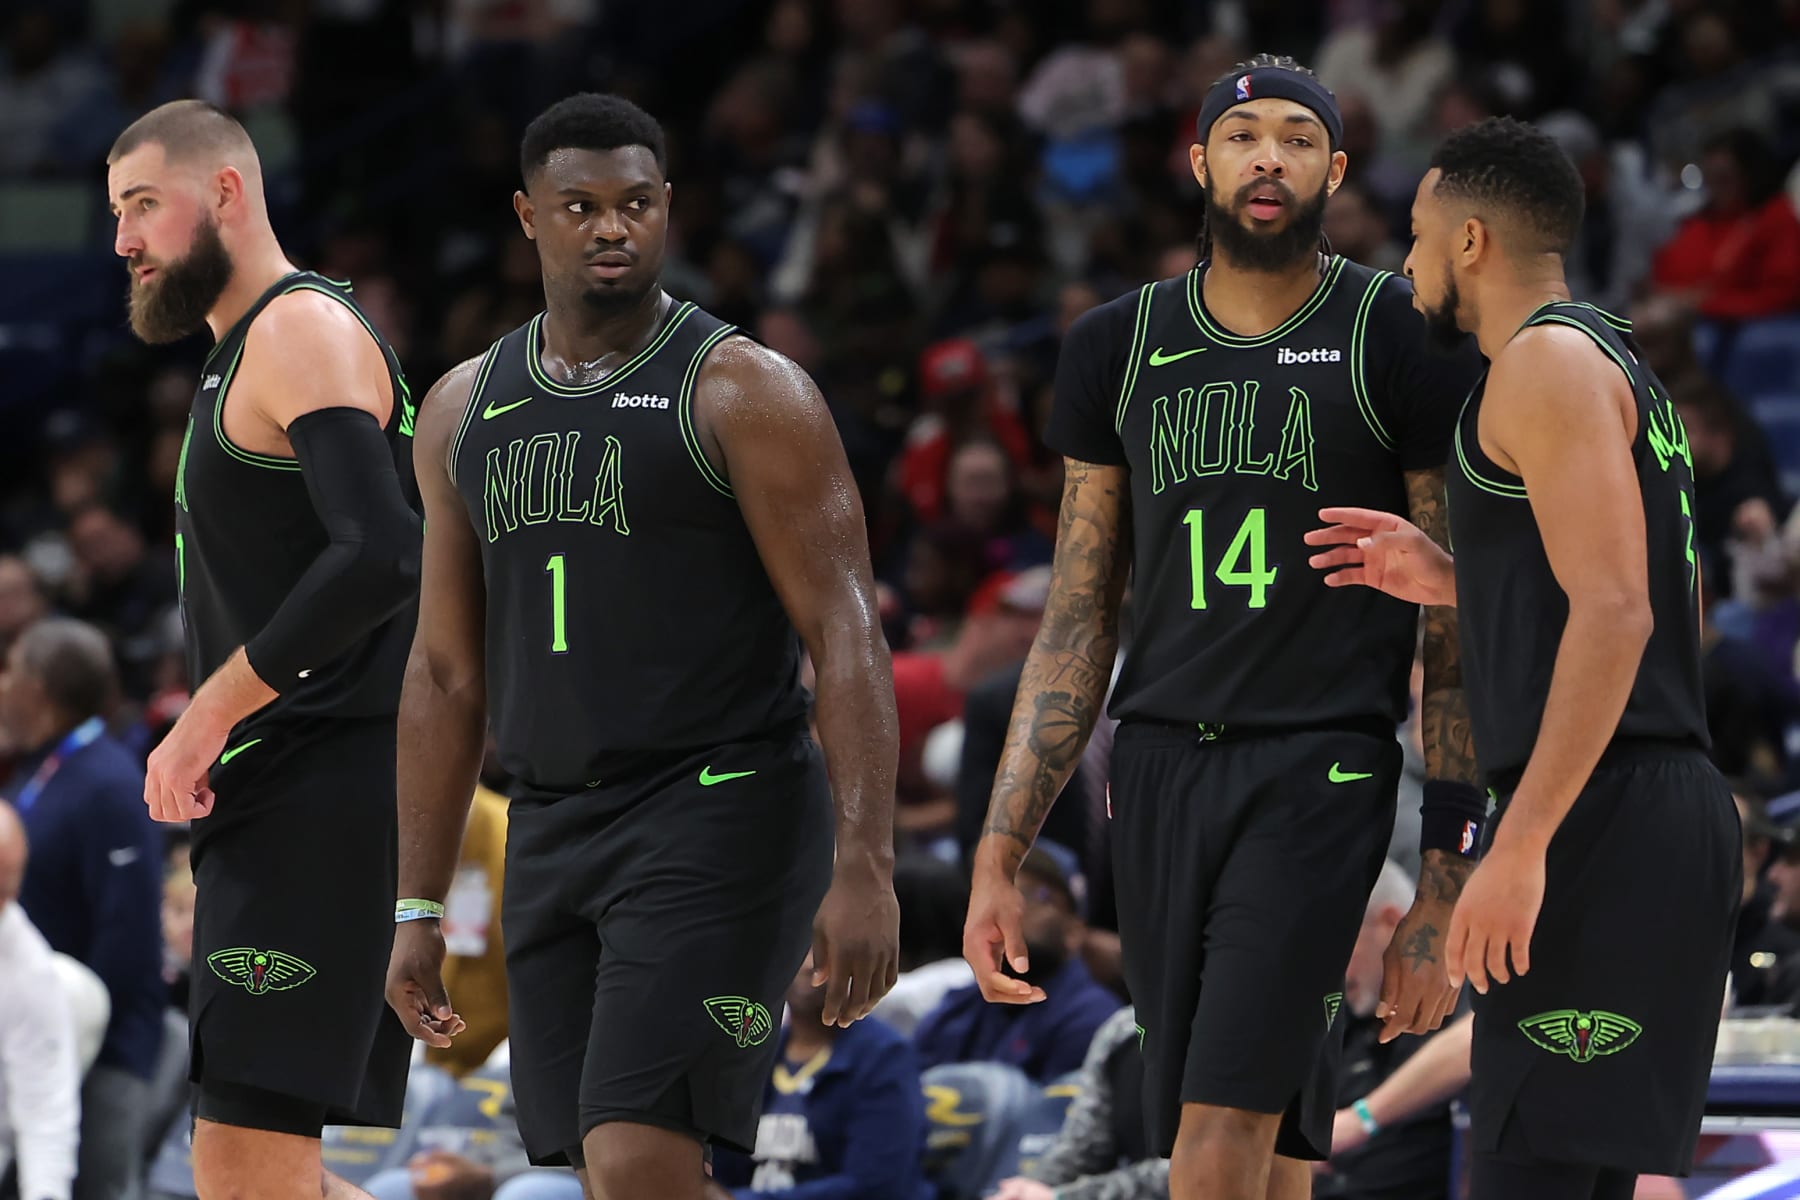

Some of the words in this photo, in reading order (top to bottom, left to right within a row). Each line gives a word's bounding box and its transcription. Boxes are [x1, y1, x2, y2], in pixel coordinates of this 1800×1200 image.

[611, 392, 670, 409] ibotta
[1277, 348, 1342, 365] ibotta
[484, 431, 630, 543] NOLA
[1150, 381, 1319, 495] NOLA
[545, 554, 569, 653] 1
[1182, 508, 1278, 609] 14
